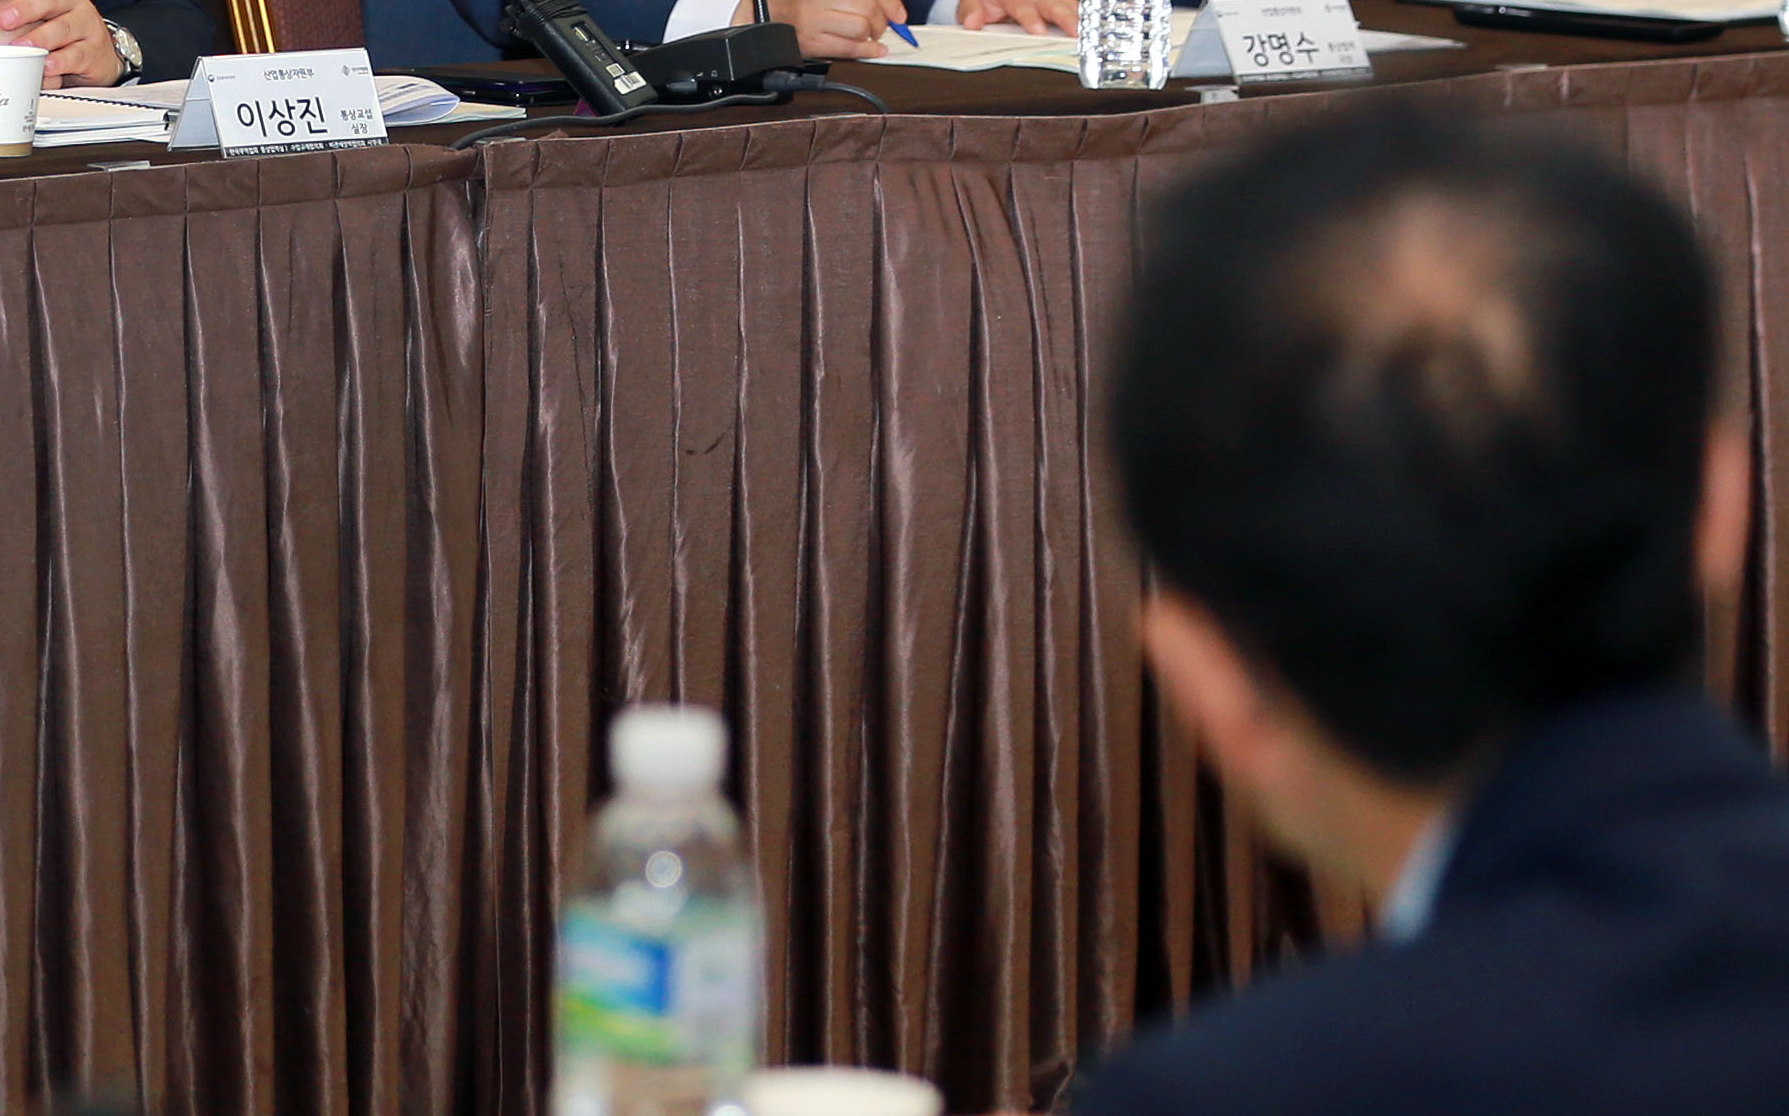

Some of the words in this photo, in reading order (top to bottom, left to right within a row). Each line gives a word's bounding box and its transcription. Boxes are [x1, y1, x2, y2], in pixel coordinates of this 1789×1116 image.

[1243, 31, 1320, 67] 강명수
[263, 67, 315, 81] 산업통상자원부
[236, 96, 329, 138] 이상진
[340, 109, 374, 122] 통상교섭
[351, 123, 369, 135] 실장
